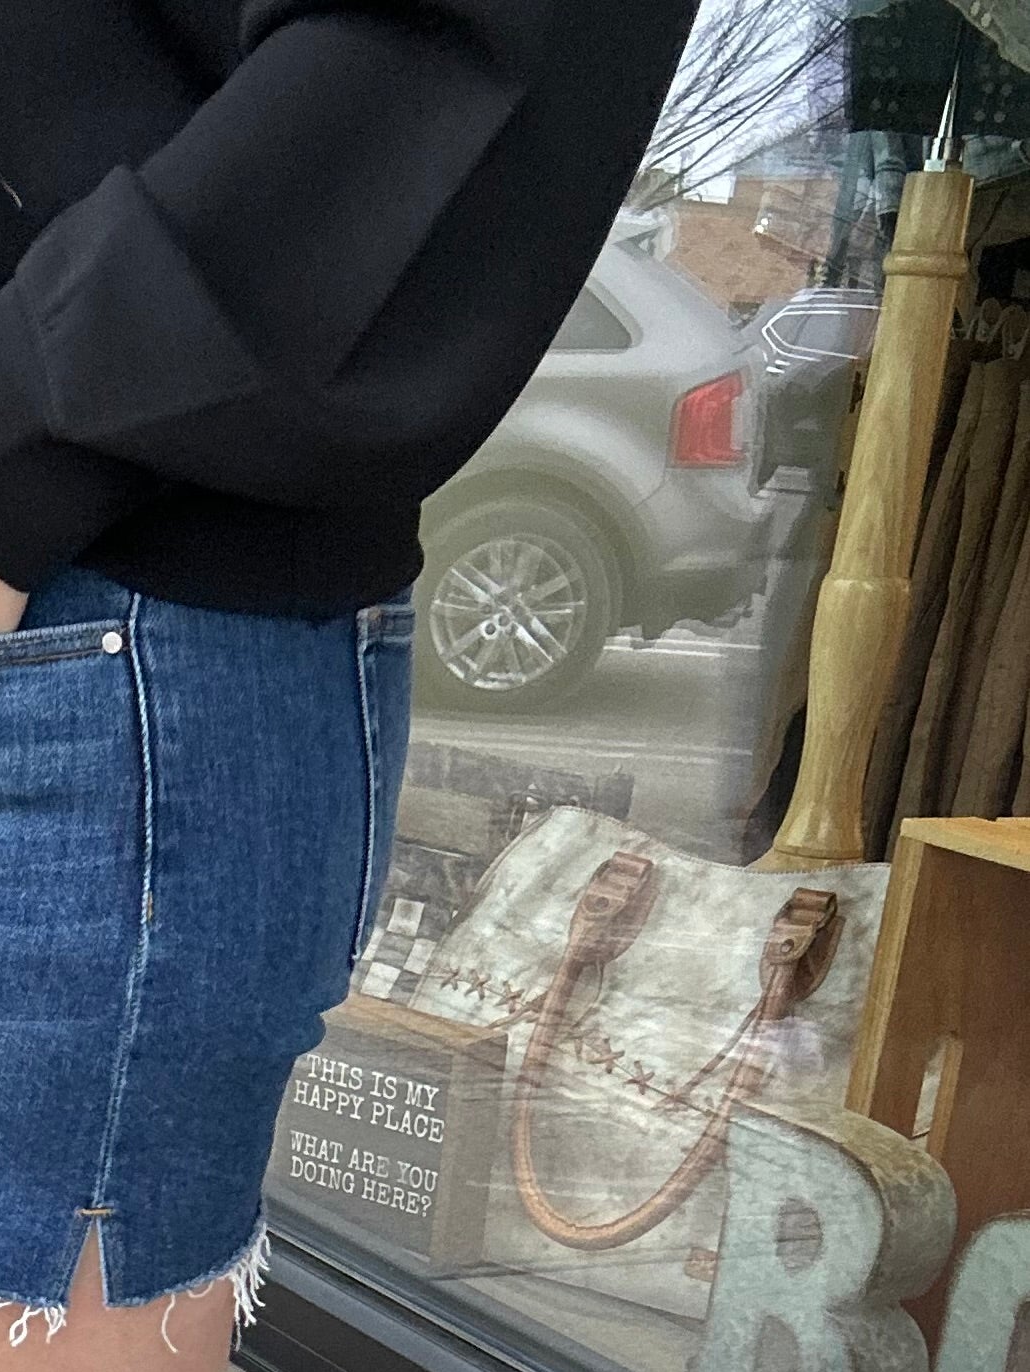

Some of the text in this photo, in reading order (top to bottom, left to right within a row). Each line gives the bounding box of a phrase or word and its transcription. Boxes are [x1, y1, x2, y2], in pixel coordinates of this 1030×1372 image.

[293, 1079, 445, 1144] HAPPY PLACE
[307, 1054, 439, 1111] THIS IS MY
[290, 1130, 439, 1192] WHAT ARE YOU
[290, 1156, 432, 1218] DOING HERE?
